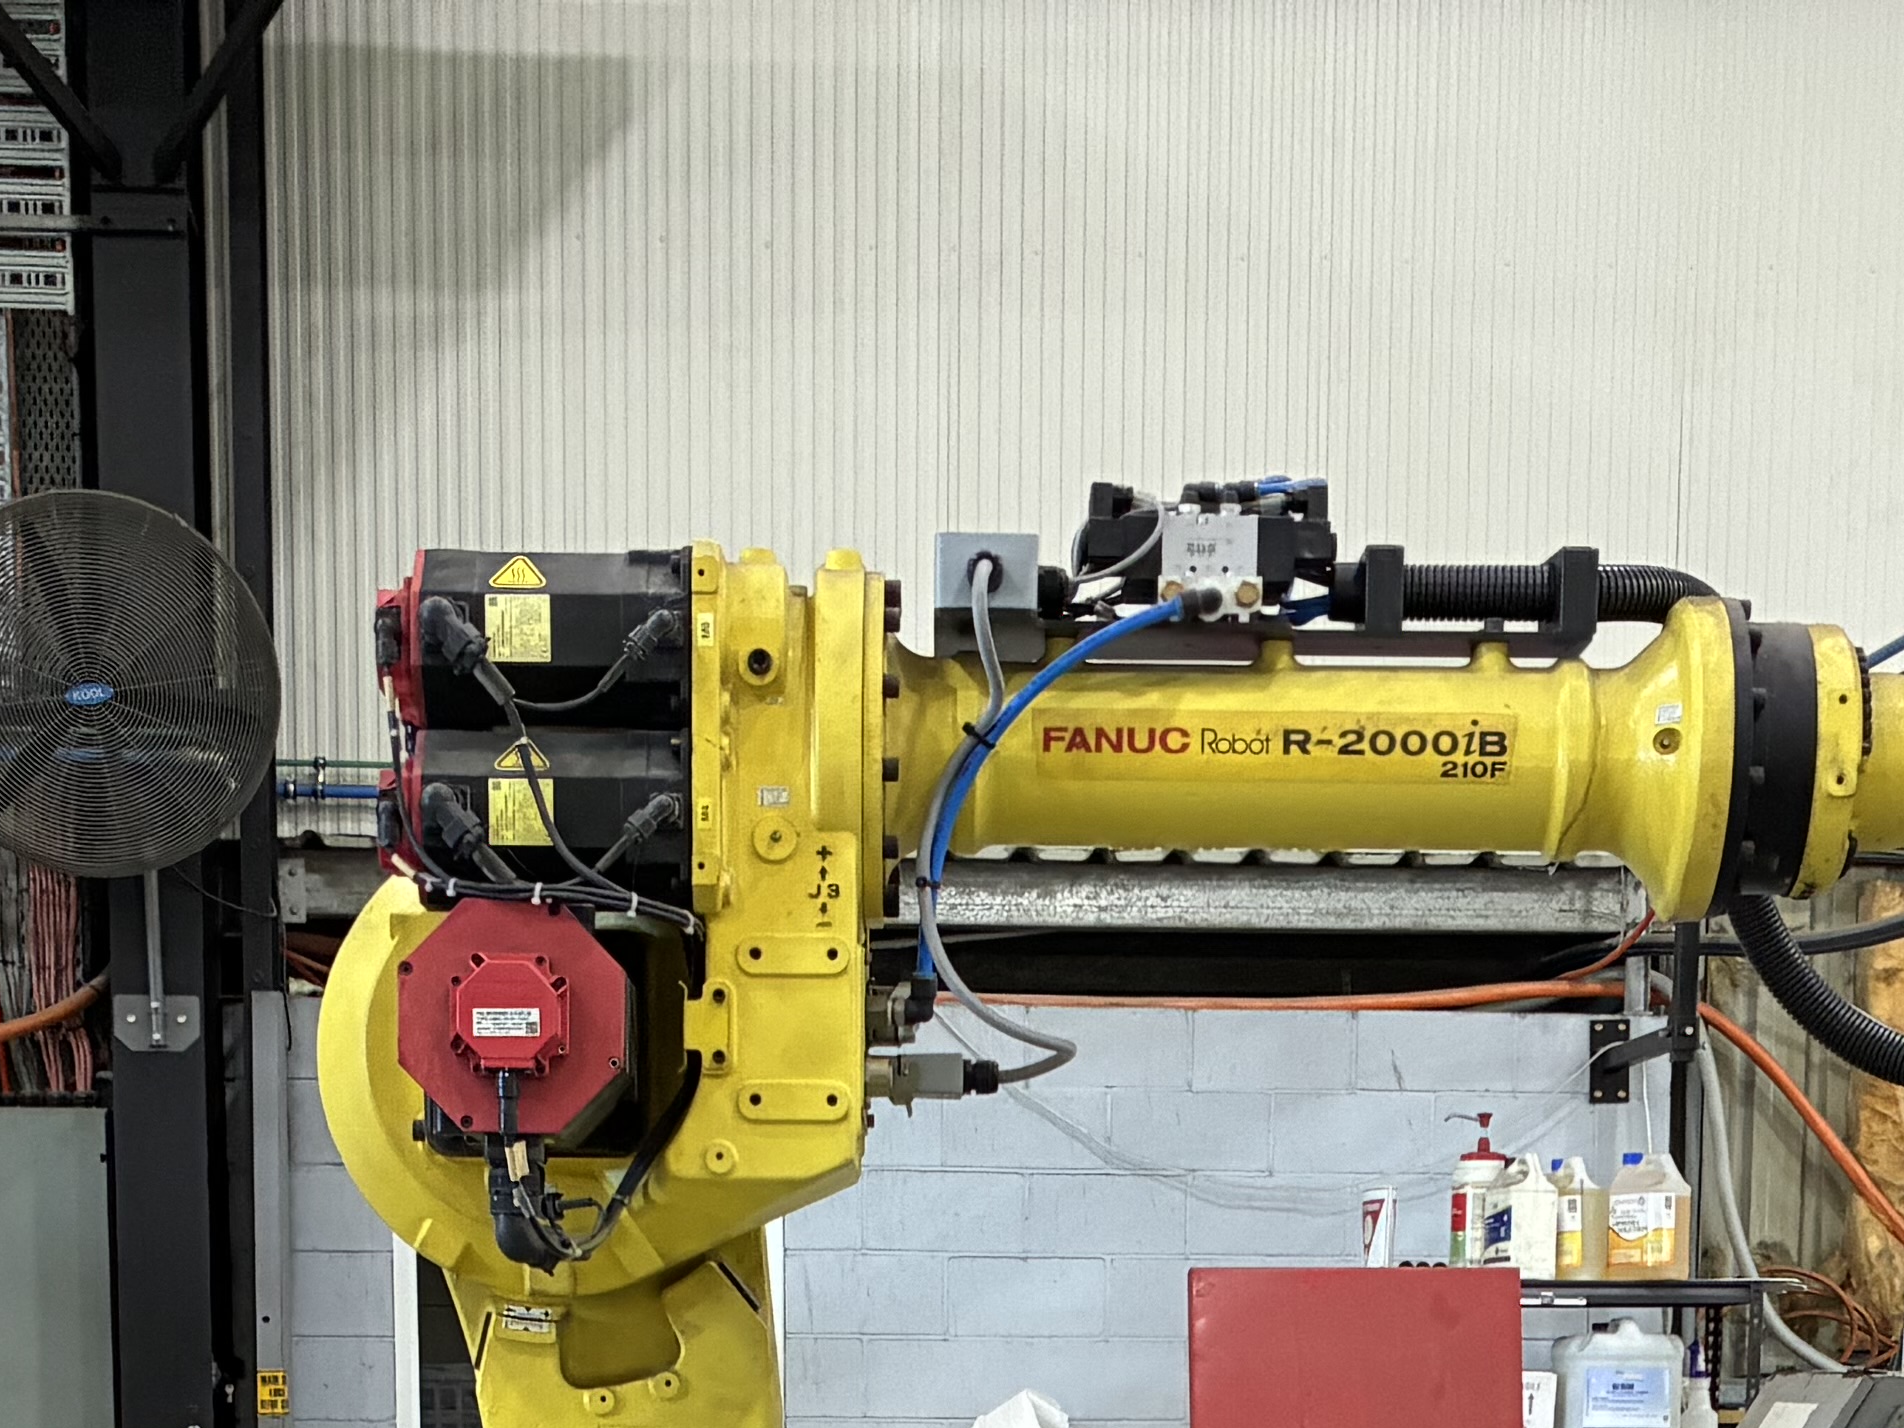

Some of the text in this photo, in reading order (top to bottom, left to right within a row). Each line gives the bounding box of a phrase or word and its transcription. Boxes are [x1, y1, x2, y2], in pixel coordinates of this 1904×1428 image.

[1042, 719, 1508, 757] FANUC Robot R-2000iB
[1440, 761, 1507, 779] 210F
[808, 883, 840, 900] J3
